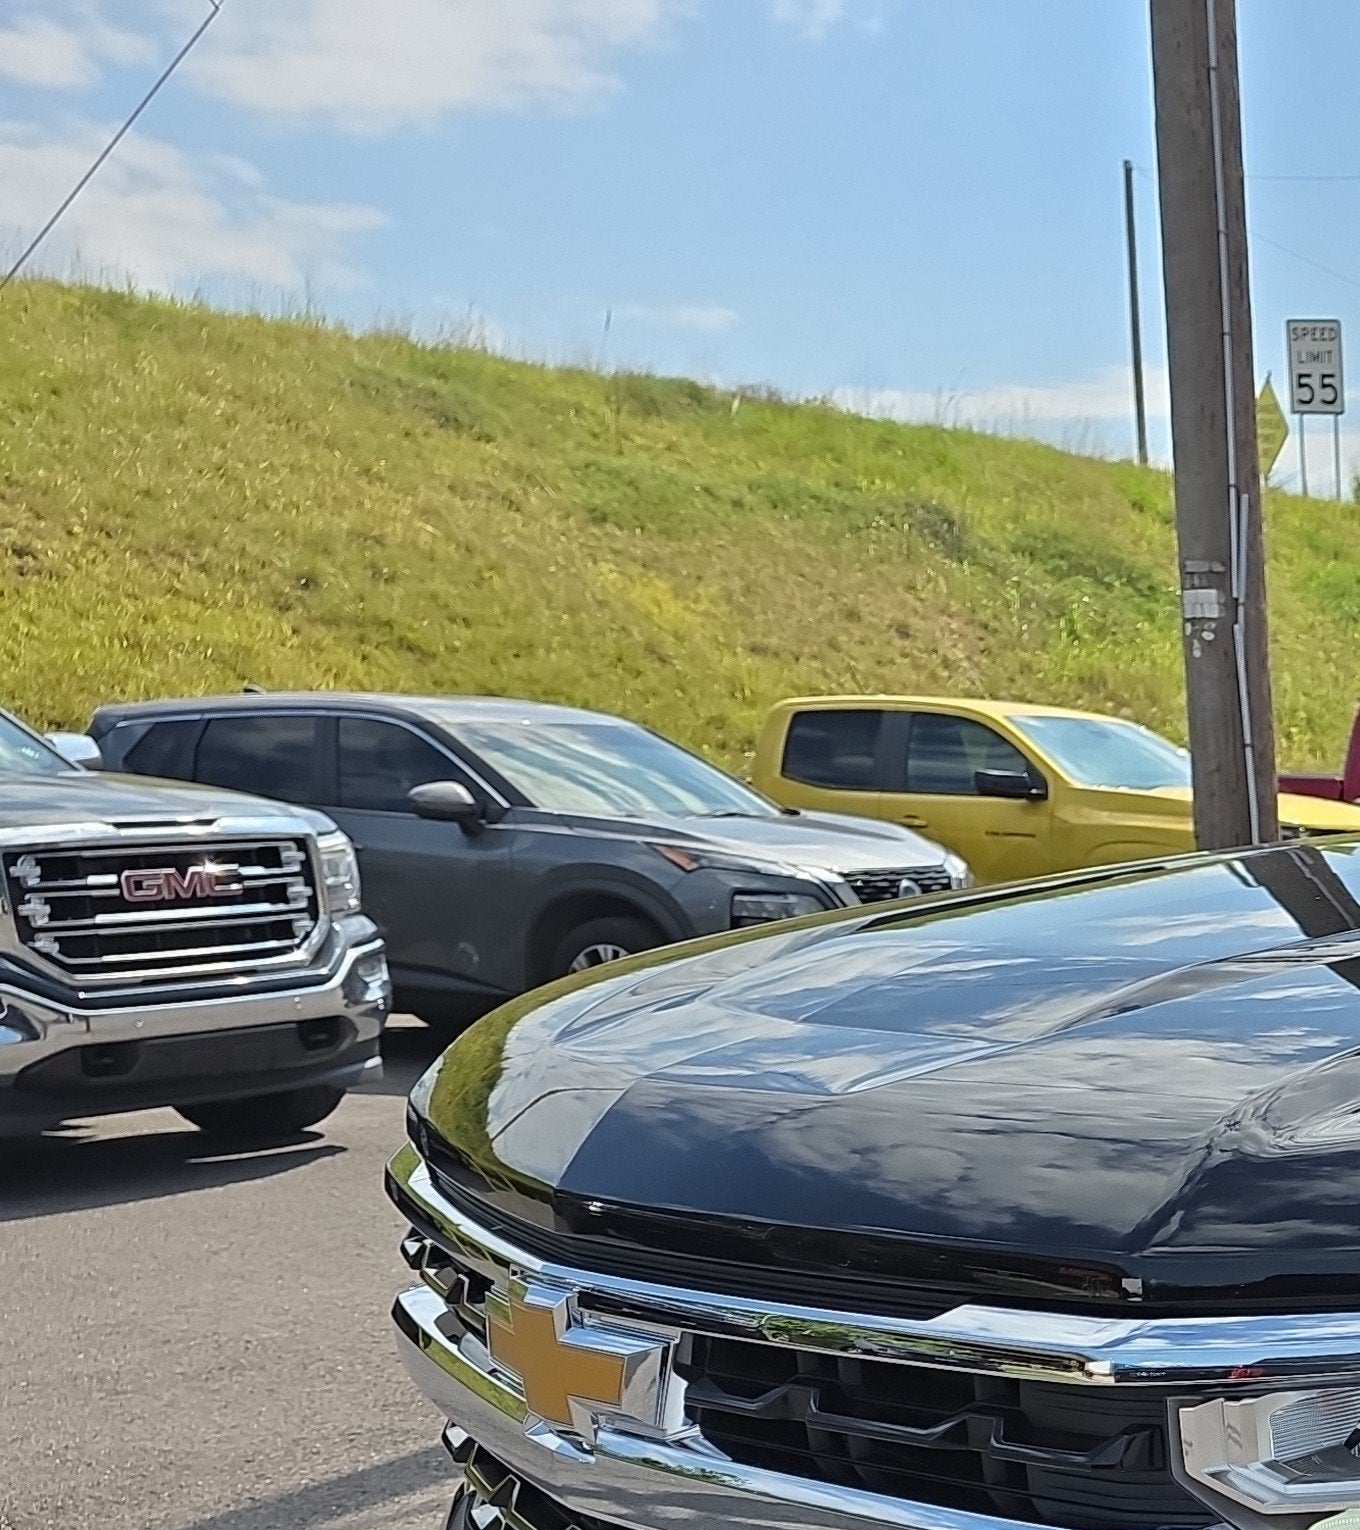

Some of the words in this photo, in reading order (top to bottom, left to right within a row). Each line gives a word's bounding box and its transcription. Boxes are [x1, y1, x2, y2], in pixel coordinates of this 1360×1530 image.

[1291, 326, 1338, 342] SPEED
[1297, 349, 1333, 364] LIMIT
[1297, 373, 1338, 405] 55
[120, 864, 244, 902] GMC
